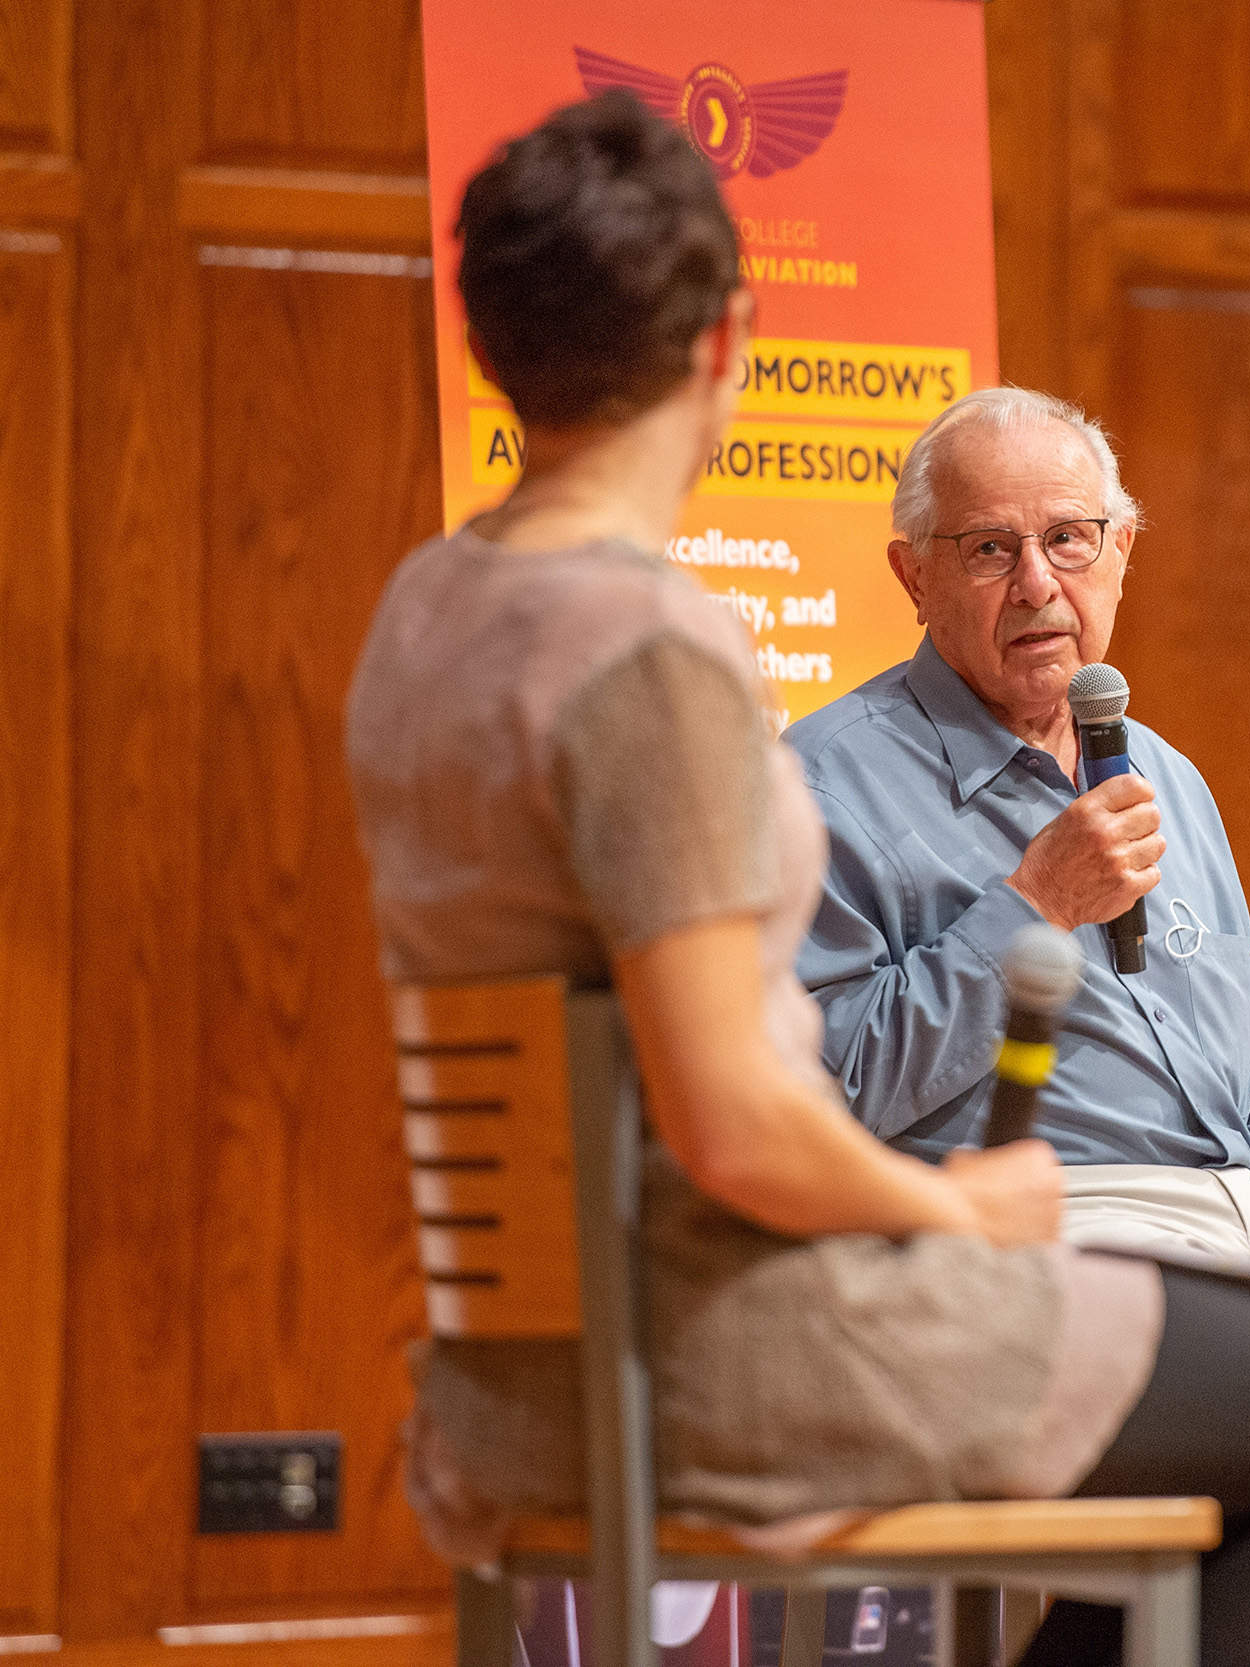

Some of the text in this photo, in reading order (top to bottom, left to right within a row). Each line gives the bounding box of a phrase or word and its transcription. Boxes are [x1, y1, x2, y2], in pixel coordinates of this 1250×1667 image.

[732, 356, 955, 401] OMORROW'S
[706, 440, 901, 482] ROFESSION
[665, 528, 800, 575] xcellence,
[781, 588, 837, 627] and
[756, 643, 833, 682] thers
